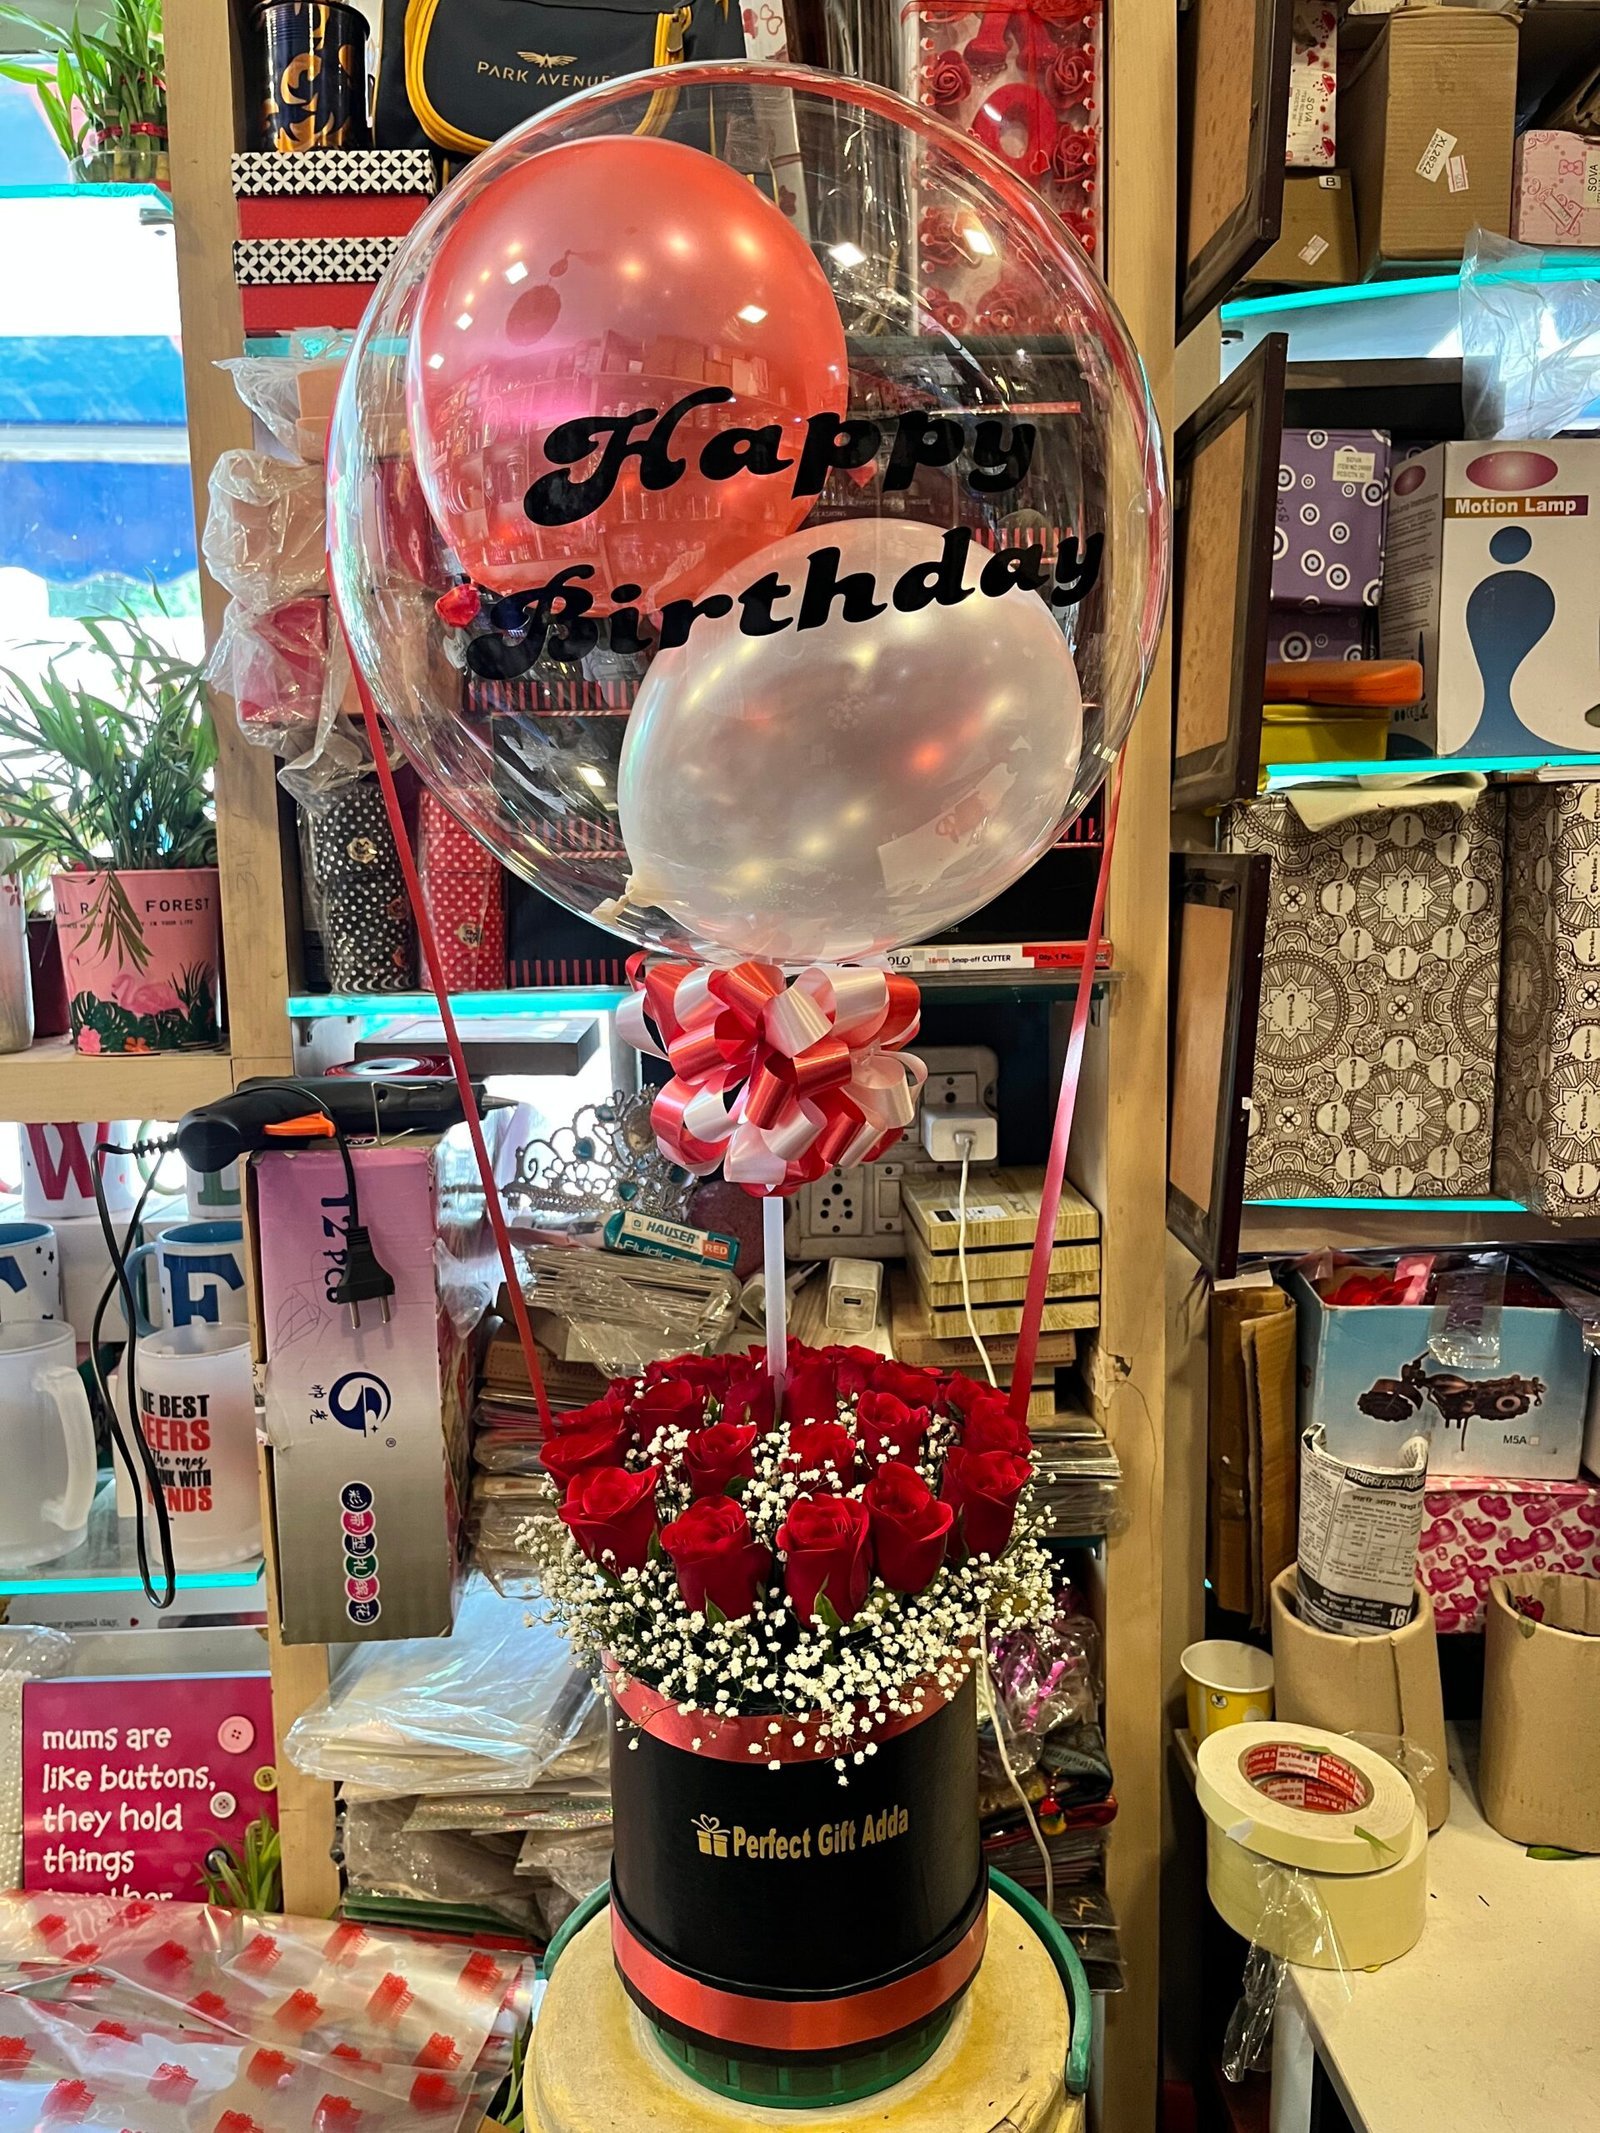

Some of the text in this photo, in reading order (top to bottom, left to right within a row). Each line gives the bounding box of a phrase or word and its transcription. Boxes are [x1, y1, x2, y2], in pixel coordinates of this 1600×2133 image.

[477, 61, 610, 87] PARK AVENUE
[1304, 97, 1314, 122] SOVA
[1422, 136, 1447, 175] XL2622
[1326, 177, 1336, 187] B
[1588, 164, 1598, 192] SOVA
[523, 386, 1037, 527] Happy
[1455, 499, 1518, 514] Motion
[1524, 498, 1577, 515] Lamp
[466, 526, 1105, 680] Birthday
[58, 904, 70, 915] AL
[146, 898, 210, 913] FOREST
[888, 955, 911, 966] OLO
[952, 955, 981, 964] Snap-off
[983, 954, 1011, 963] CUTTER
[646, 1220, 728, 1256] HAUSER RED
[141, 1388, 210, 1418] HE BEST
[142, 1413, 211, 1451] EERS
[1503, 1435, 1527, 1445] M5A
[175, 1456, 208, 1470] ones
[179, 1469, 212, 1487] WITH
[64, 1618, 97, 1630] special
[42, 1727, 172, 1751] mums are
[42, 1763, 216, 1793] like buttons,
[42, 1802, 183, 1838] they hold
[733, 1804, 909, 1859] Perfect Gift Adda
[43, 1844, 135, 1882] things
